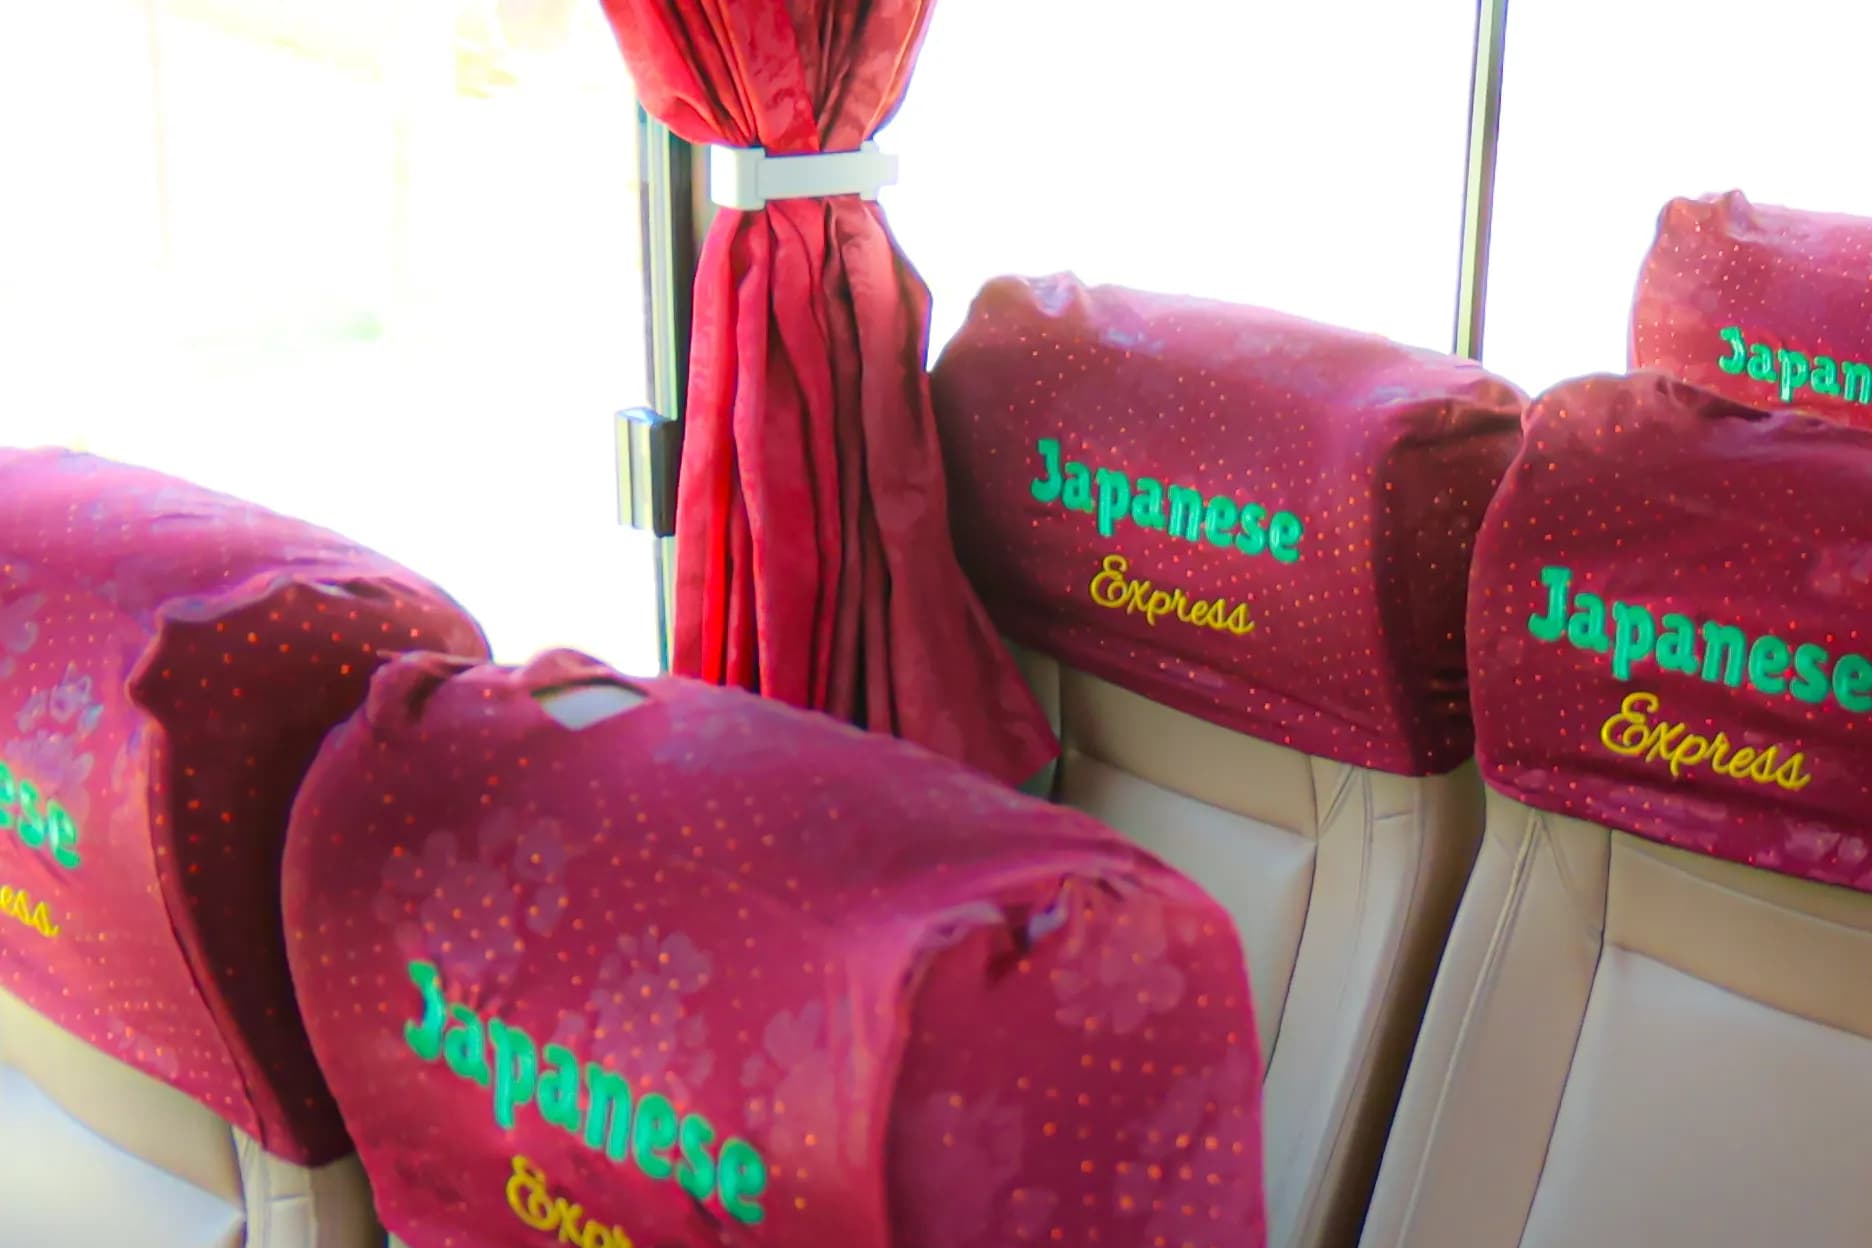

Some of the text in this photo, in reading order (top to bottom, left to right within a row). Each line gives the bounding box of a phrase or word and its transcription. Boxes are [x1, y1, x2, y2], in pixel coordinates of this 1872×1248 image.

[1029, 437, 1304, 563] Japanese
[1088, 554, 1256, 636] Express
[1600, 691, 1810, 789] Express
[404, 960, 766, 1225] Japanese
